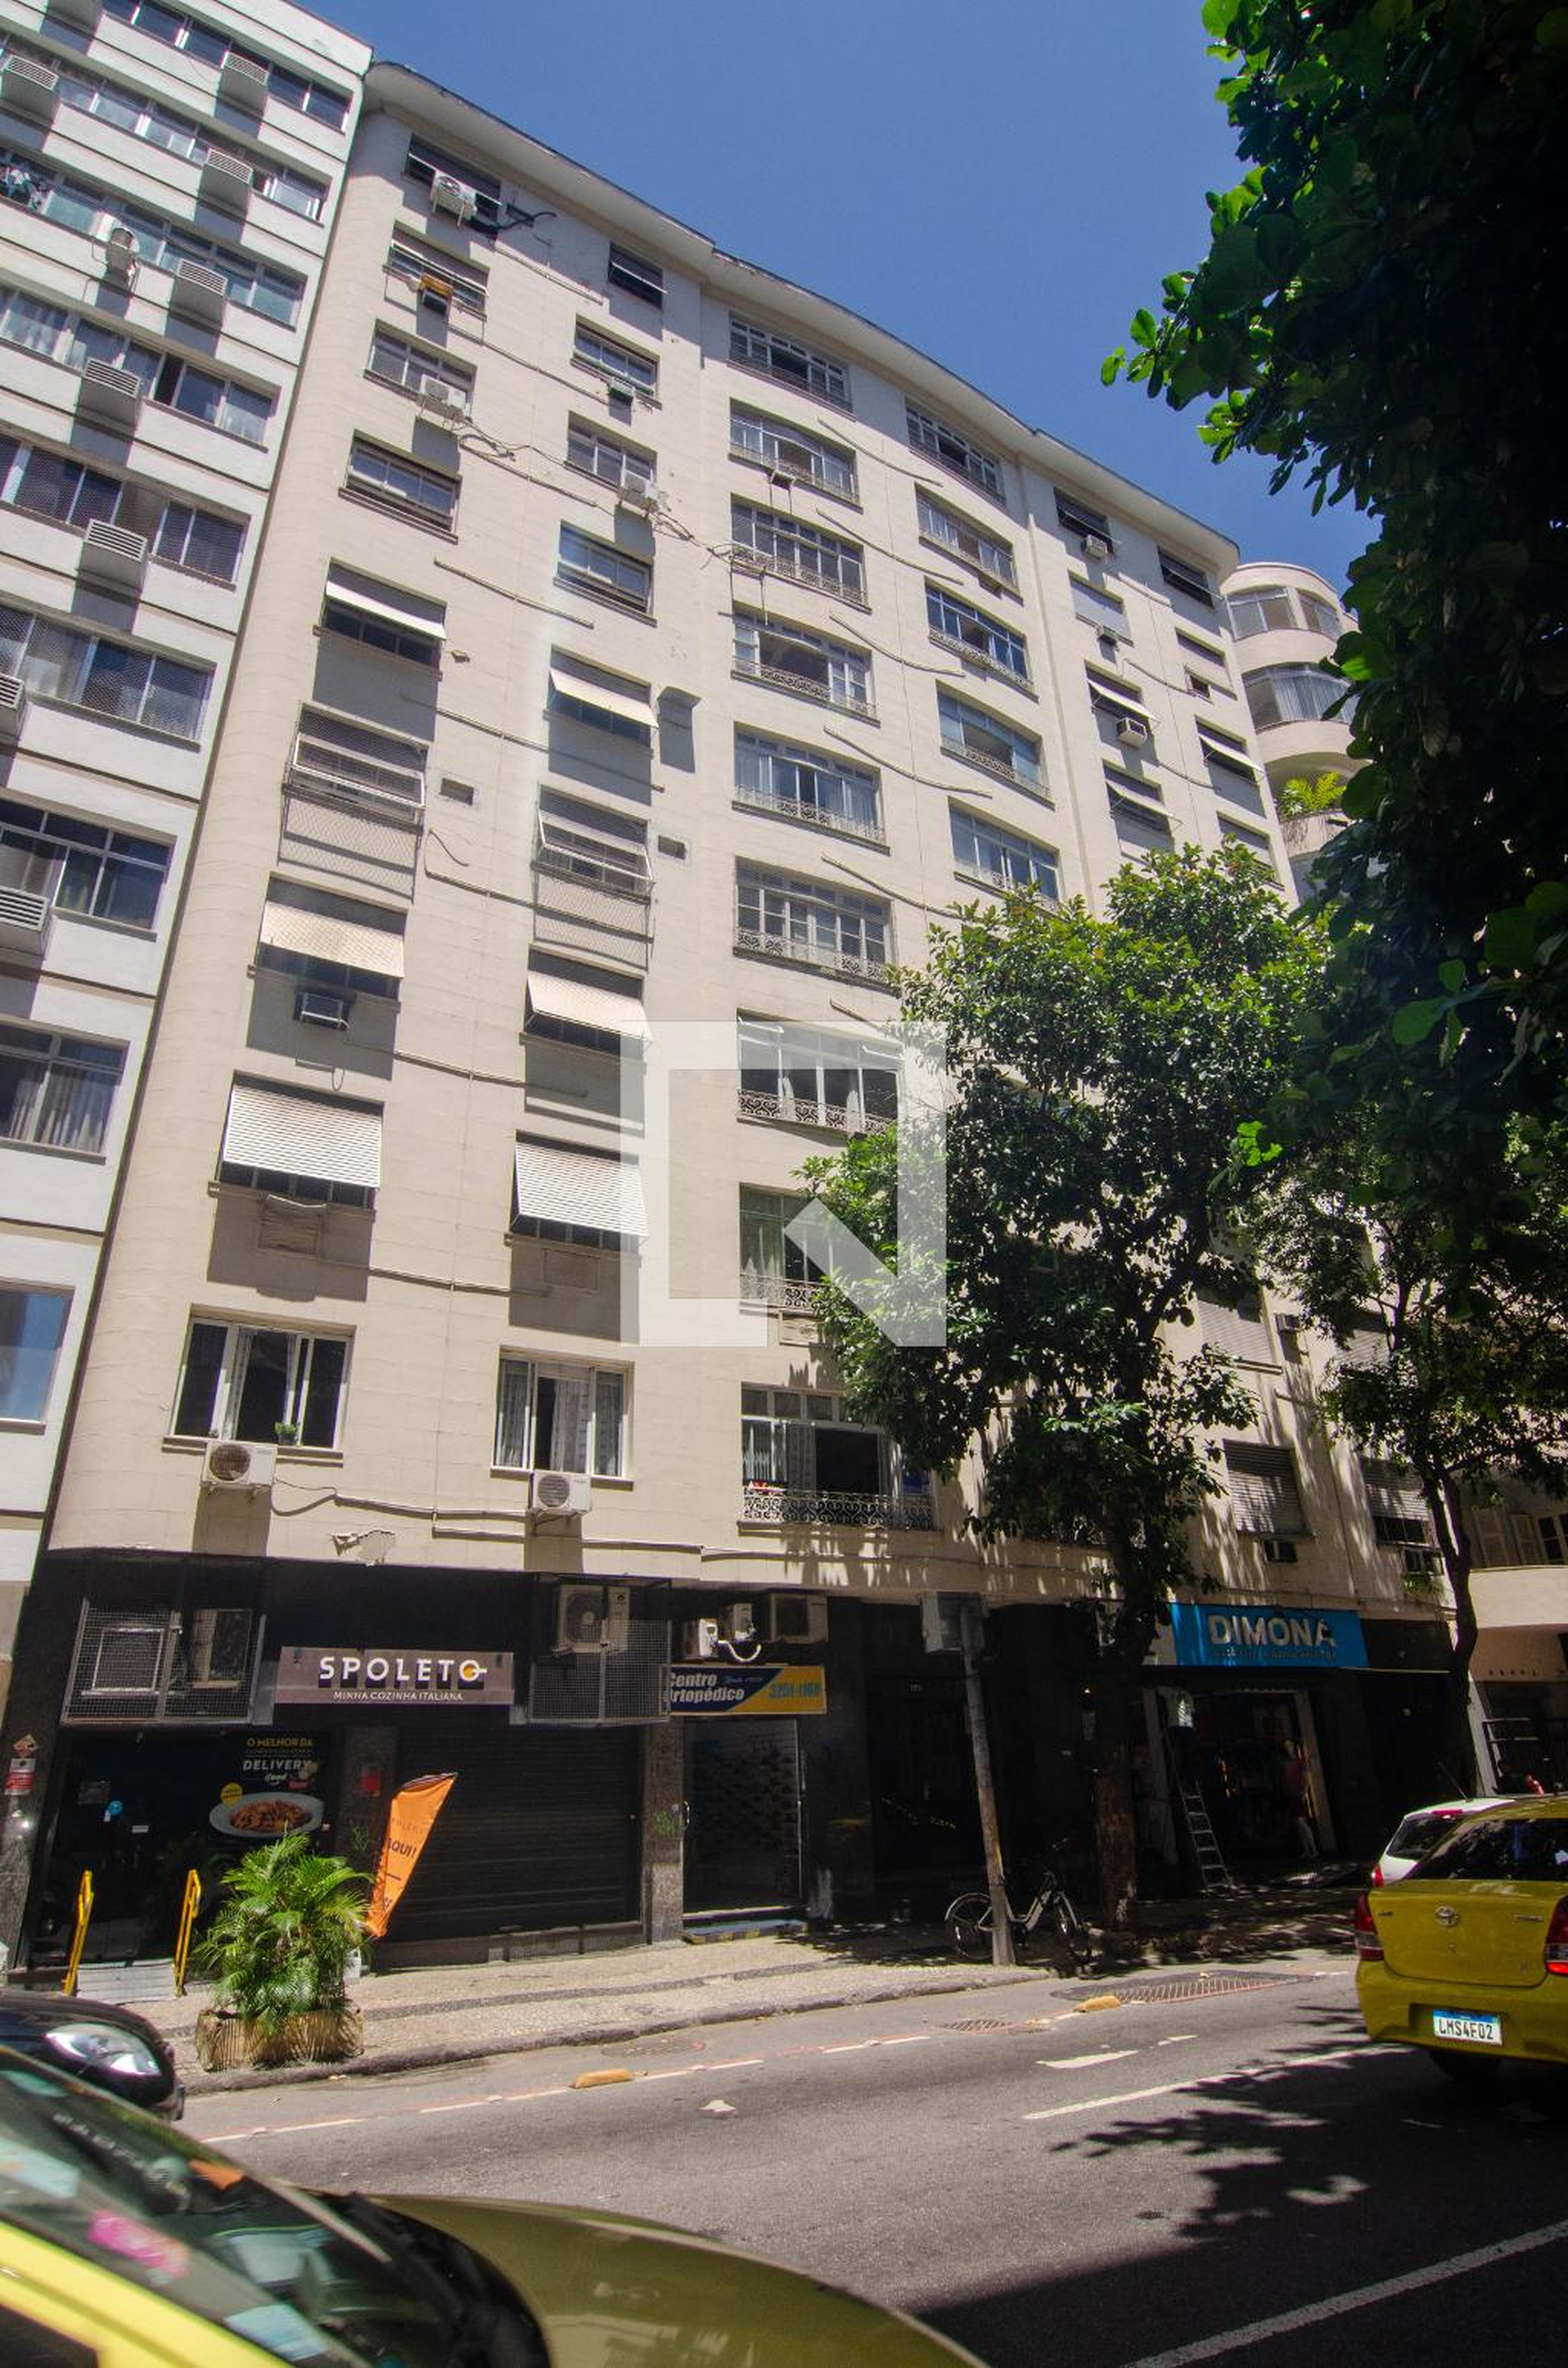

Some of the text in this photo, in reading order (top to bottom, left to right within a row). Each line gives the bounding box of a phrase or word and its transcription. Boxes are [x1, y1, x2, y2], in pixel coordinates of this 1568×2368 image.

[1208, 1615, 1336, 1647] DIMONA
[319, 1657, 487, 1681] SPOLETO
[333, 1691, 463, 1701] MINHA COZINHA ITALIANA
